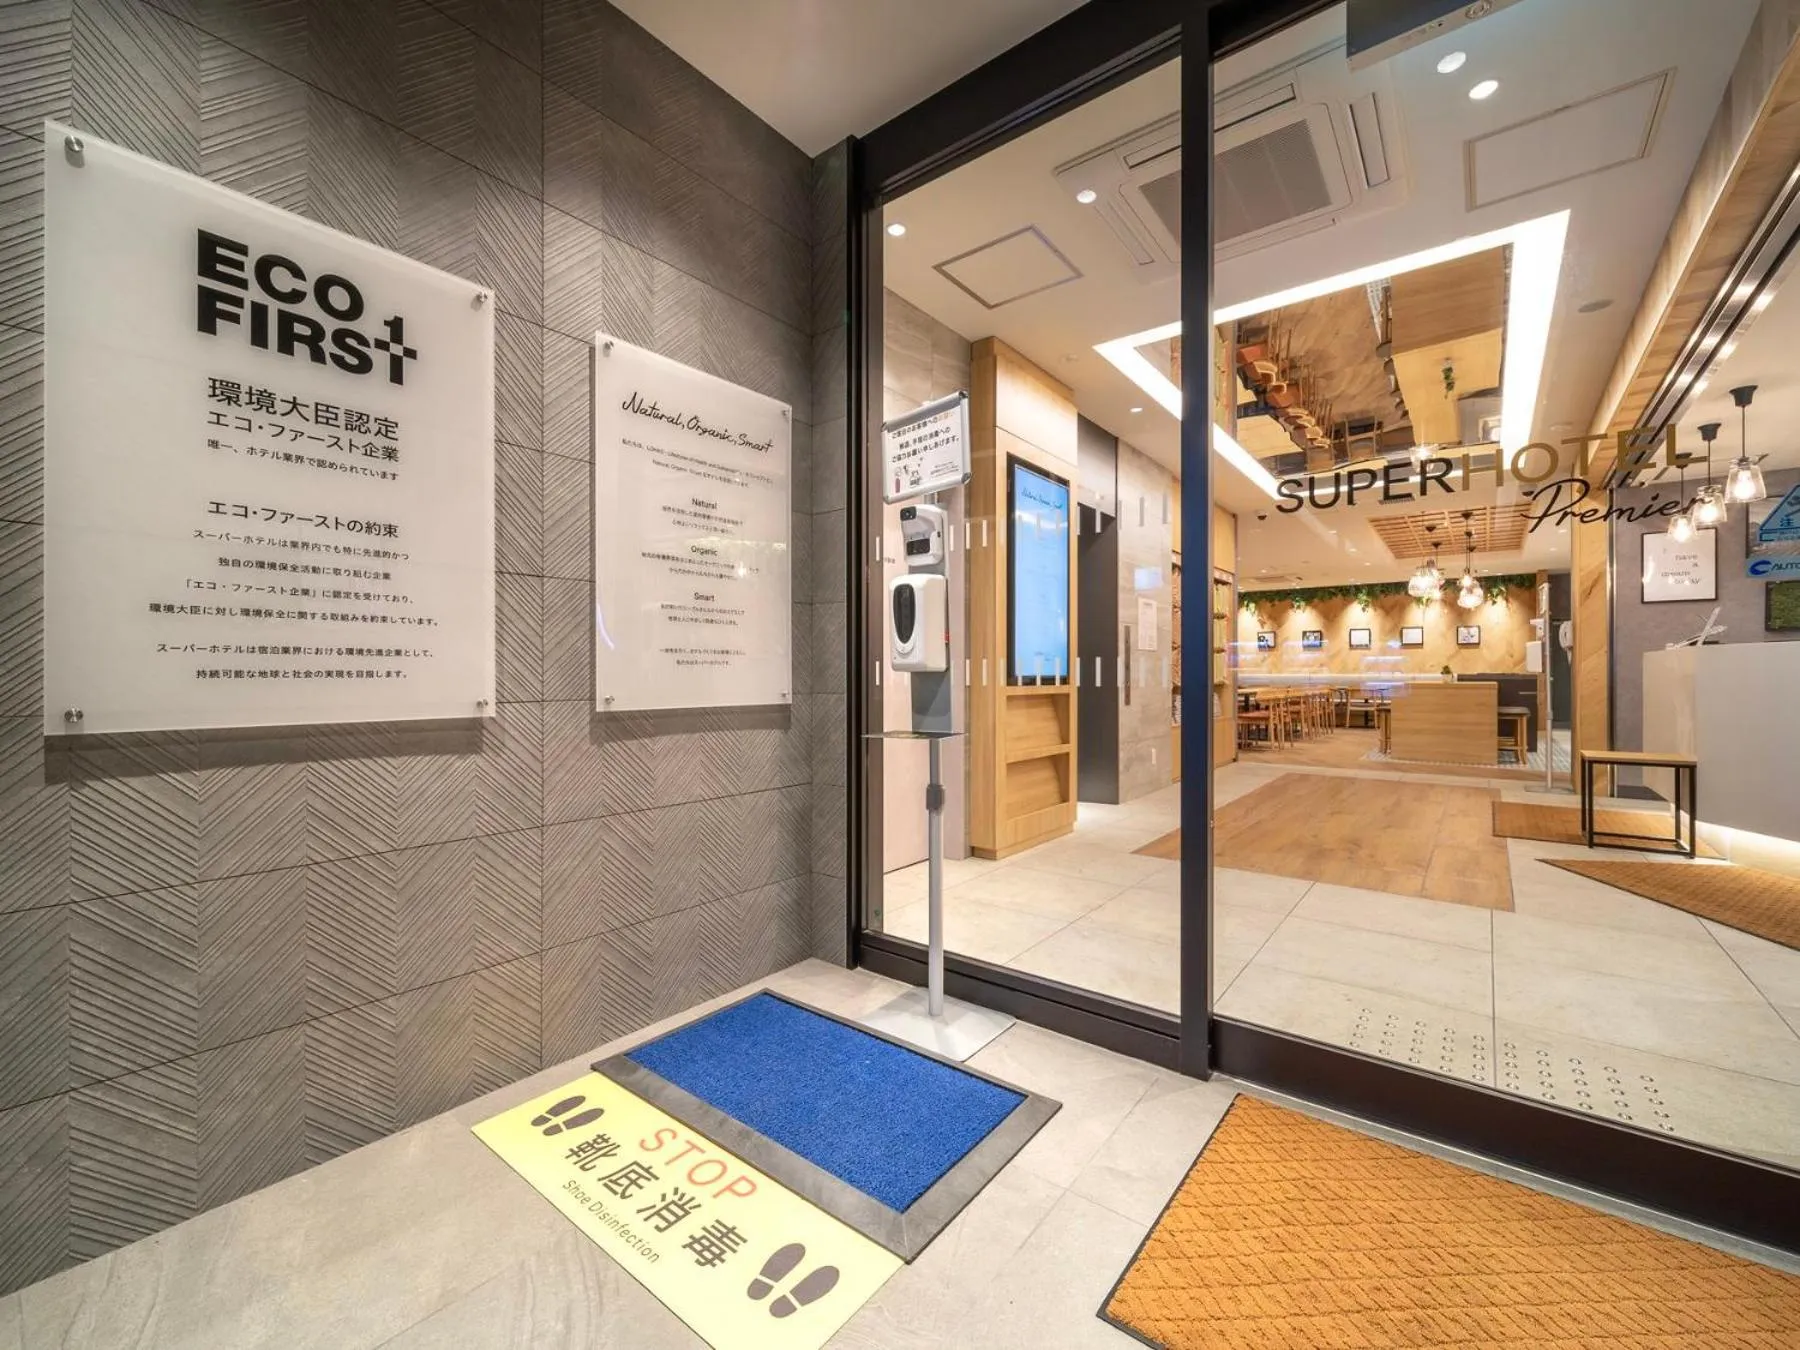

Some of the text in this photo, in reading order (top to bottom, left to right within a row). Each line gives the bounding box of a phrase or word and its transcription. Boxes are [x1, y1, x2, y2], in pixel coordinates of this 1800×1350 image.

[198, 228, 364, 322] ECO
[208, 377, 399, 441] 環境大臣認定
[207, 411, 399, 463] エコ・ファースト企業
[737, 432, 774, 454] Smart
[207, 438, 399, 481] 唯一、ホテル業界で認められています
[208, 501, 399, 538] エコ・ファーストの約束
[692, 498, 717, 511] Natural
[1520, 478, 1713, 534] Premier
[193, 529, 409, 561] スーパーホテルは業界内でも特に先進的かつ
[691, 545, 718, 557] Organic
[218, 557, 391, 581] 独自の環境保全活動に取り組む企業
[694, 592, 715, 603] Smart
[196, 669, 408, 680] 持続可能な地球と社会の実現を目指します。
[639, 1127, 757, 1198] STOP
[565, 1133, 748, 1268] 靴底消毒
[562, 1179, 660, 1264] Shoe Disinfection
